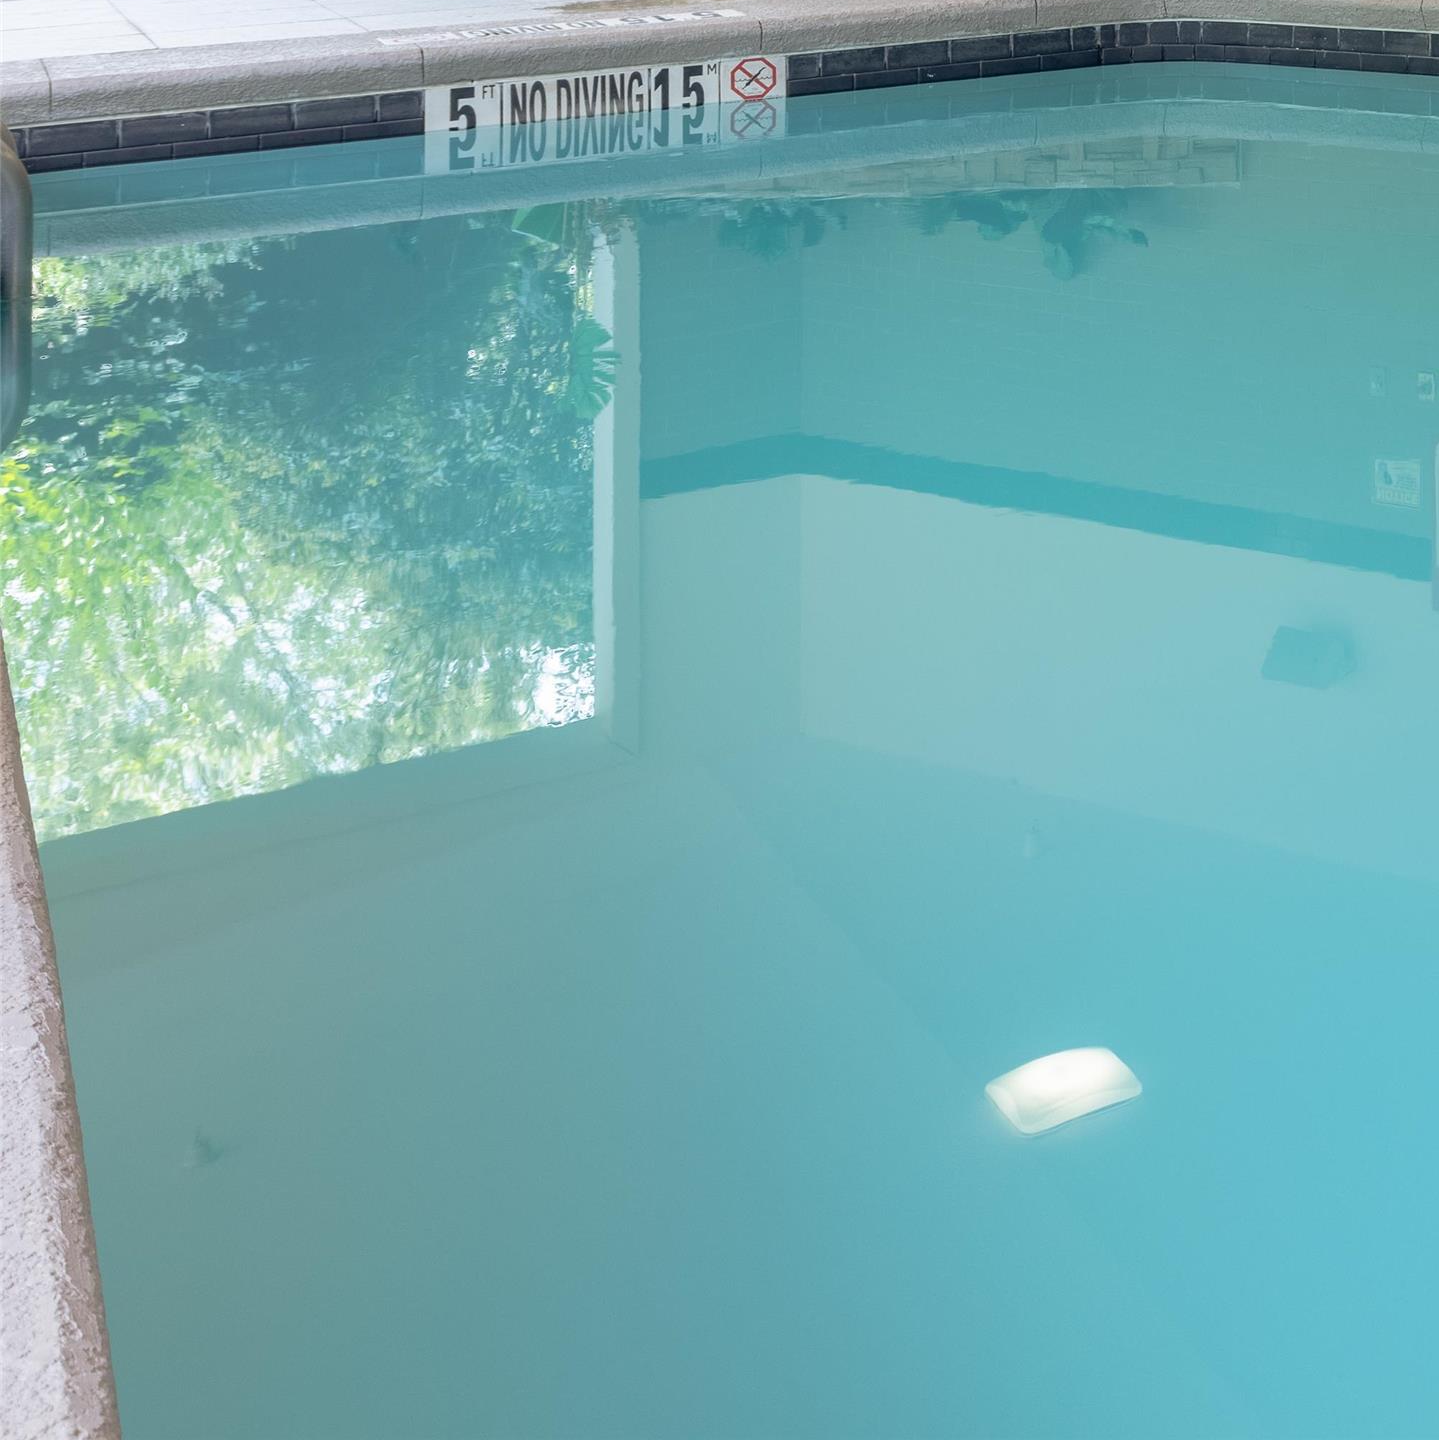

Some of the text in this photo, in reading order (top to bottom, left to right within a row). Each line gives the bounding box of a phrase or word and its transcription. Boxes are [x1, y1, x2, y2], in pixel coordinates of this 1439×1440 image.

[467, 20, 602, 38] NO DIVING
[449, 86, 477, 131] 5
[482, 84, 496, 100] FT
[510, 80, 547, 125] NO
[556, 71, 644, 120] DIVING
[707, 65, 718, 76] M
